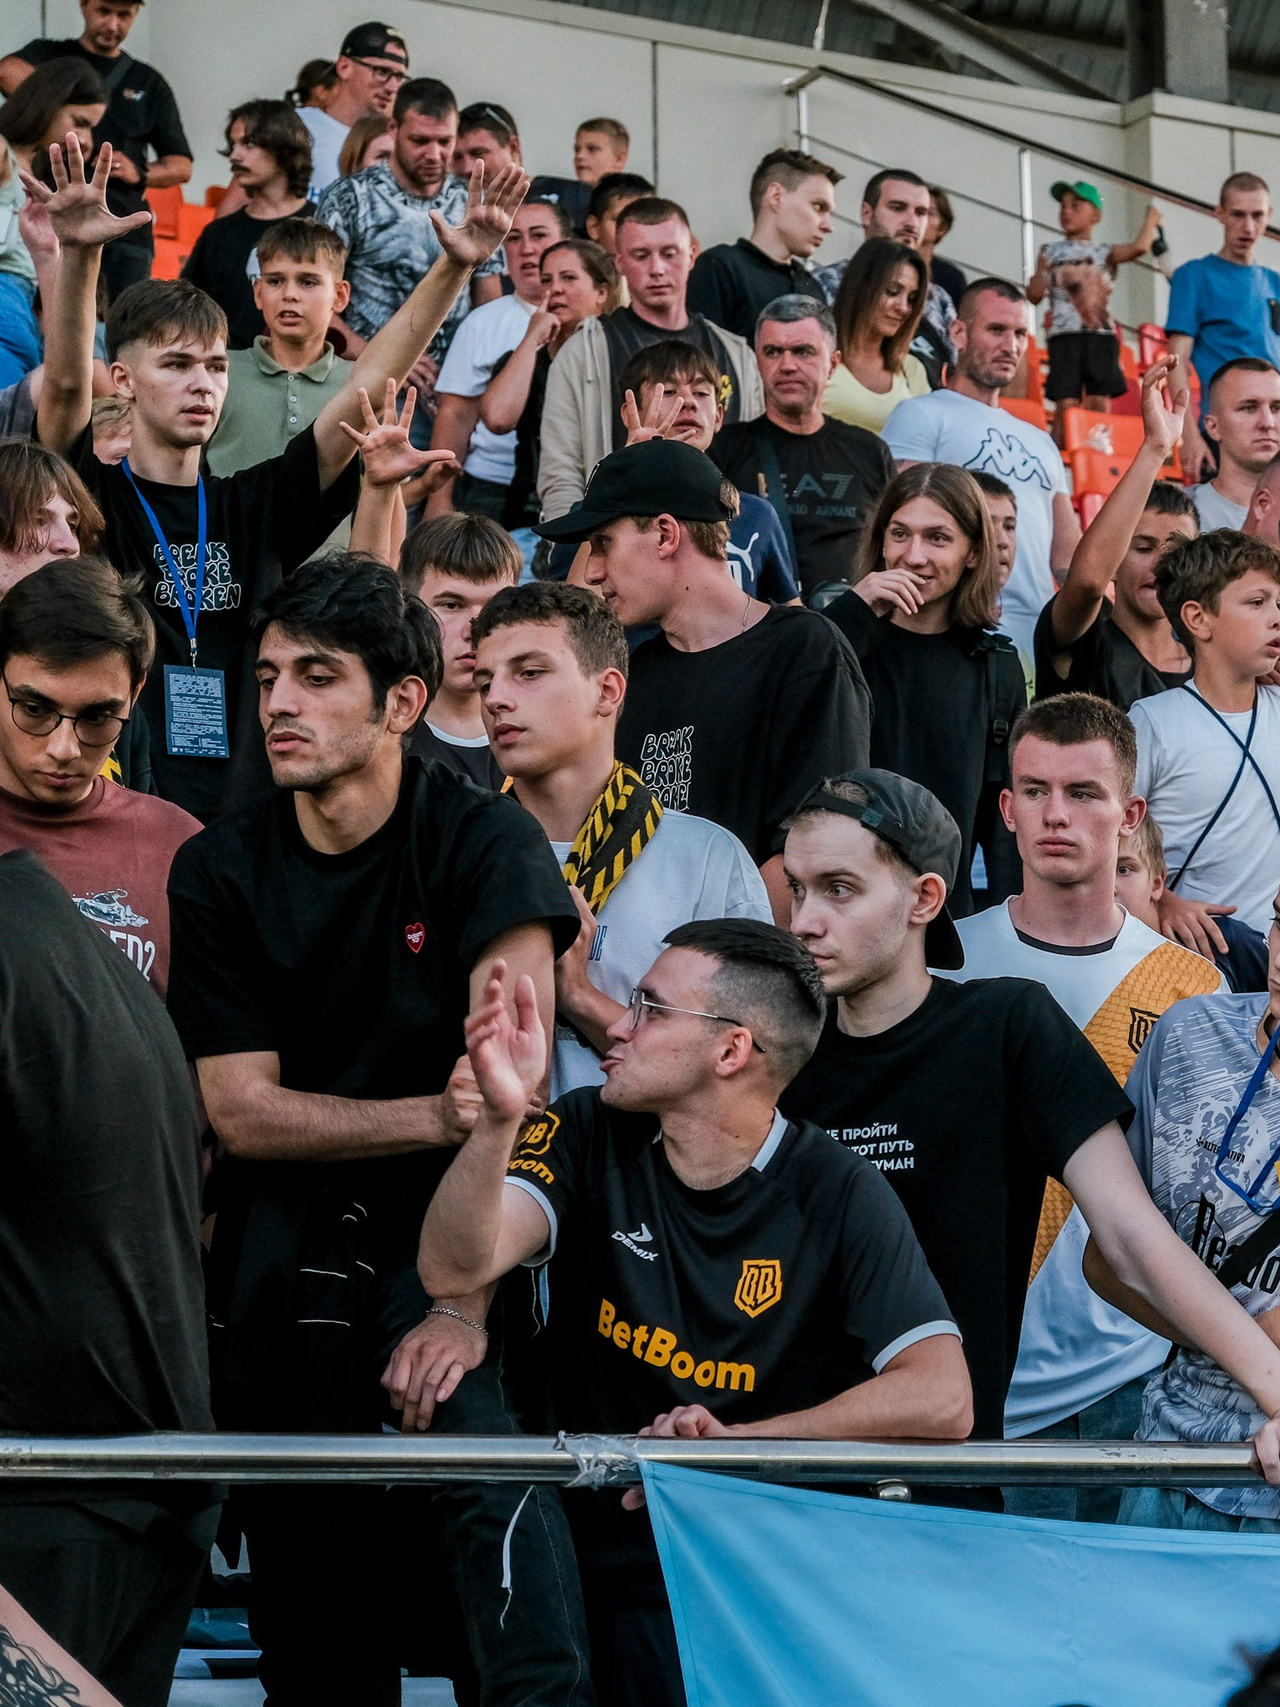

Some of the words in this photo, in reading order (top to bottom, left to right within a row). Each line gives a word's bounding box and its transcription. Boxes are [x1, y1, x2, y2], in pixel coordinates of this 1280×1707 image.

[842, 1121, 898, 1141] ПРОЙТИ
[846, 1143, 877, 1157] ТОТ
[878, 1138, 915, 1155] ПУТЬ
[870, 1156, 915, 1172] УМАН
[611, 1230, 659, 1262] DEMIX
[597, 1297, 756, 1393] BetBoom
